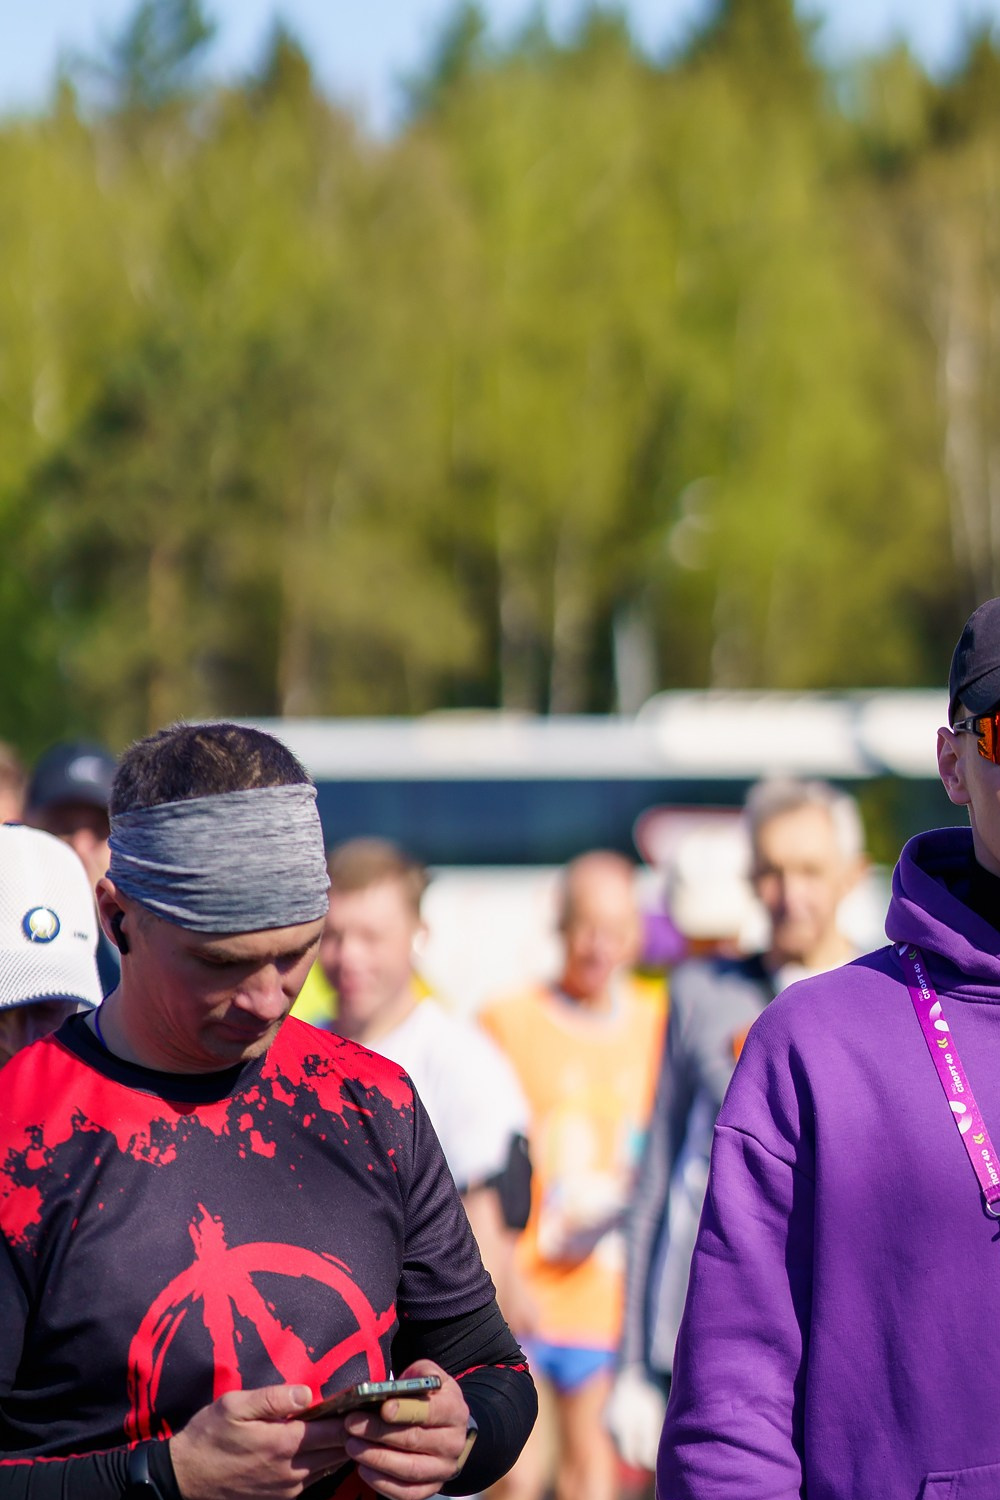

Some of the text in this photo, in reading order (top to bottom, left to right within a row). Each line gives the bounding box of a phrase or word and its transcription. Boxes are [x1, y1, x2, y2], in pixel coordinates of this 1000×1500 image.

[914, 963, 931, 1000] СПОРТ 40
[944, 1053, 964, 1093] СПОРТ 40
[981, 1149, 1000, 1185] ПОРТ 40
